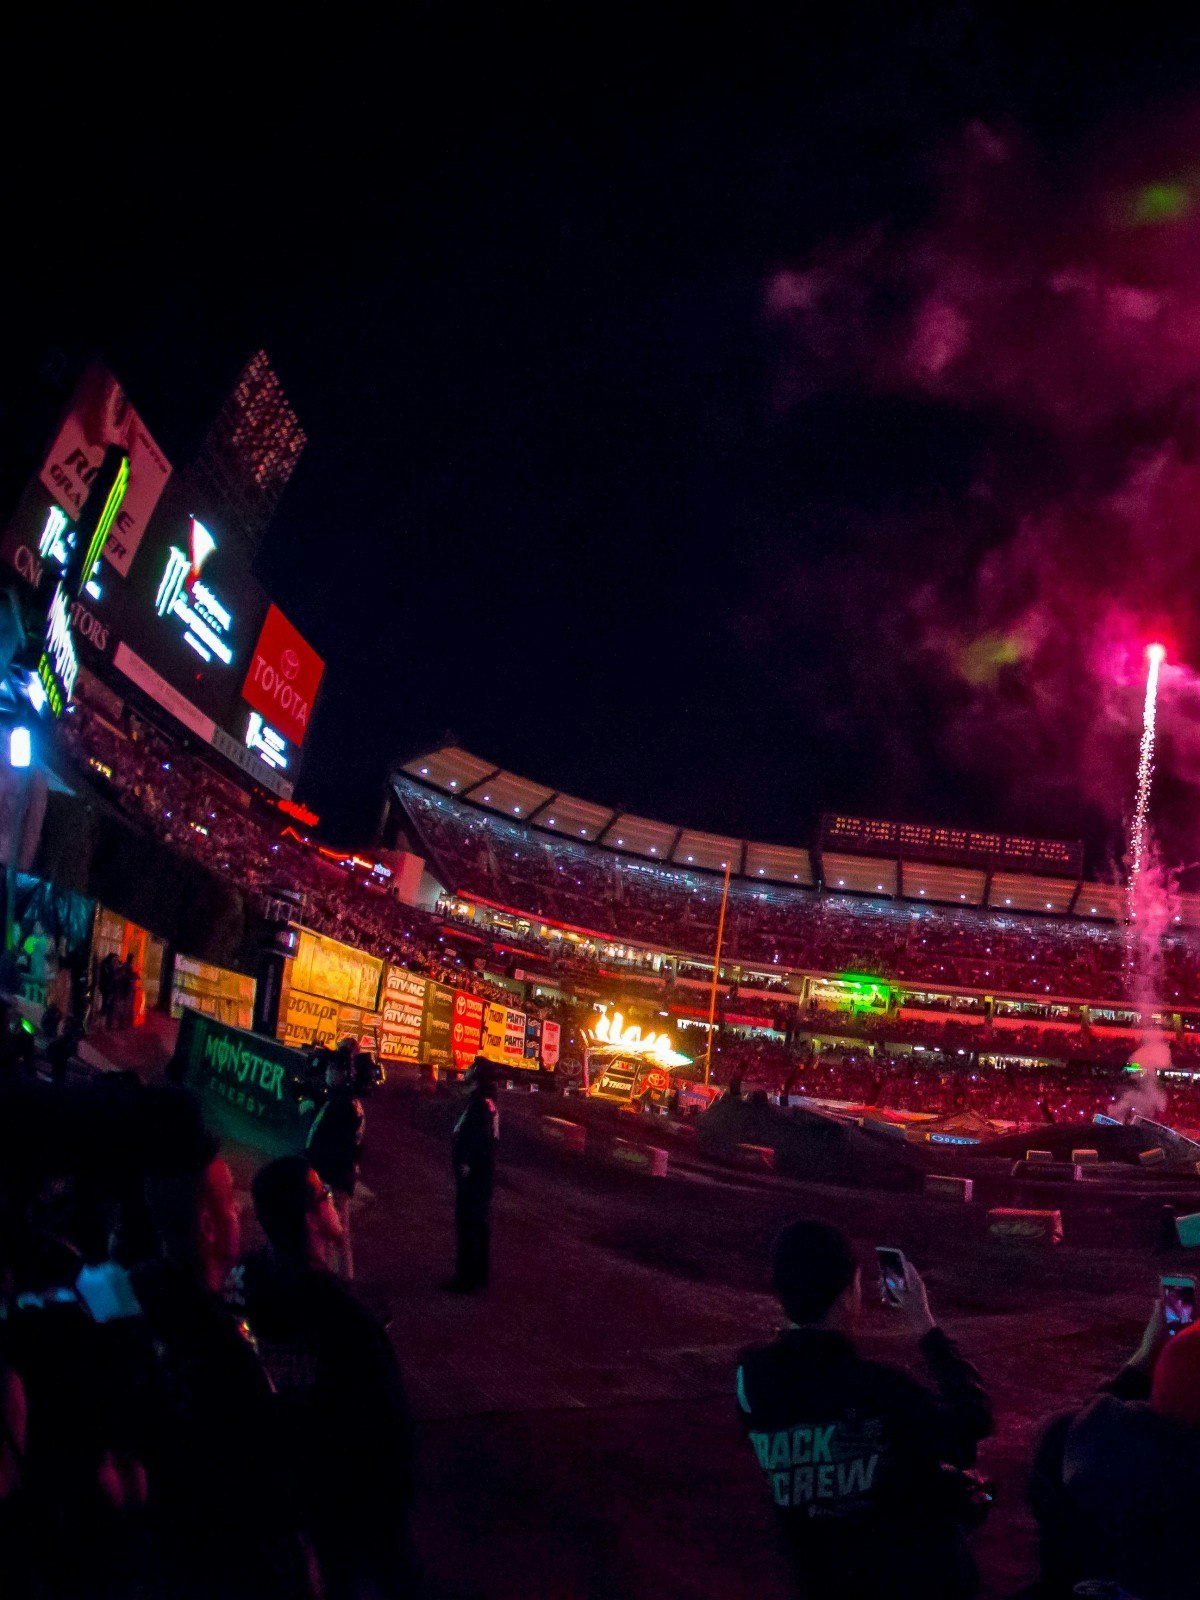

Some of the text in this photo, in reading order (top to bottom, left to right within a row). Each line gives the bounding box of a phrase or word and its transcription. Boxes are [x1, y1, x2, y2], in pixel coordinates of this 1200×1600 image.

[254, 655, 308, 727] TOYOTA
[288, 998, 337, 1020] DUNLOP
[507, 1011, 525, 1026] PARTS
[504, 1034, 524, 1048] PARTS
[205, 1034, 285, 1100] MONSTER
[608, 1080, 632, 1090] THOR
[772, 1453, 879, 1507] CREW
